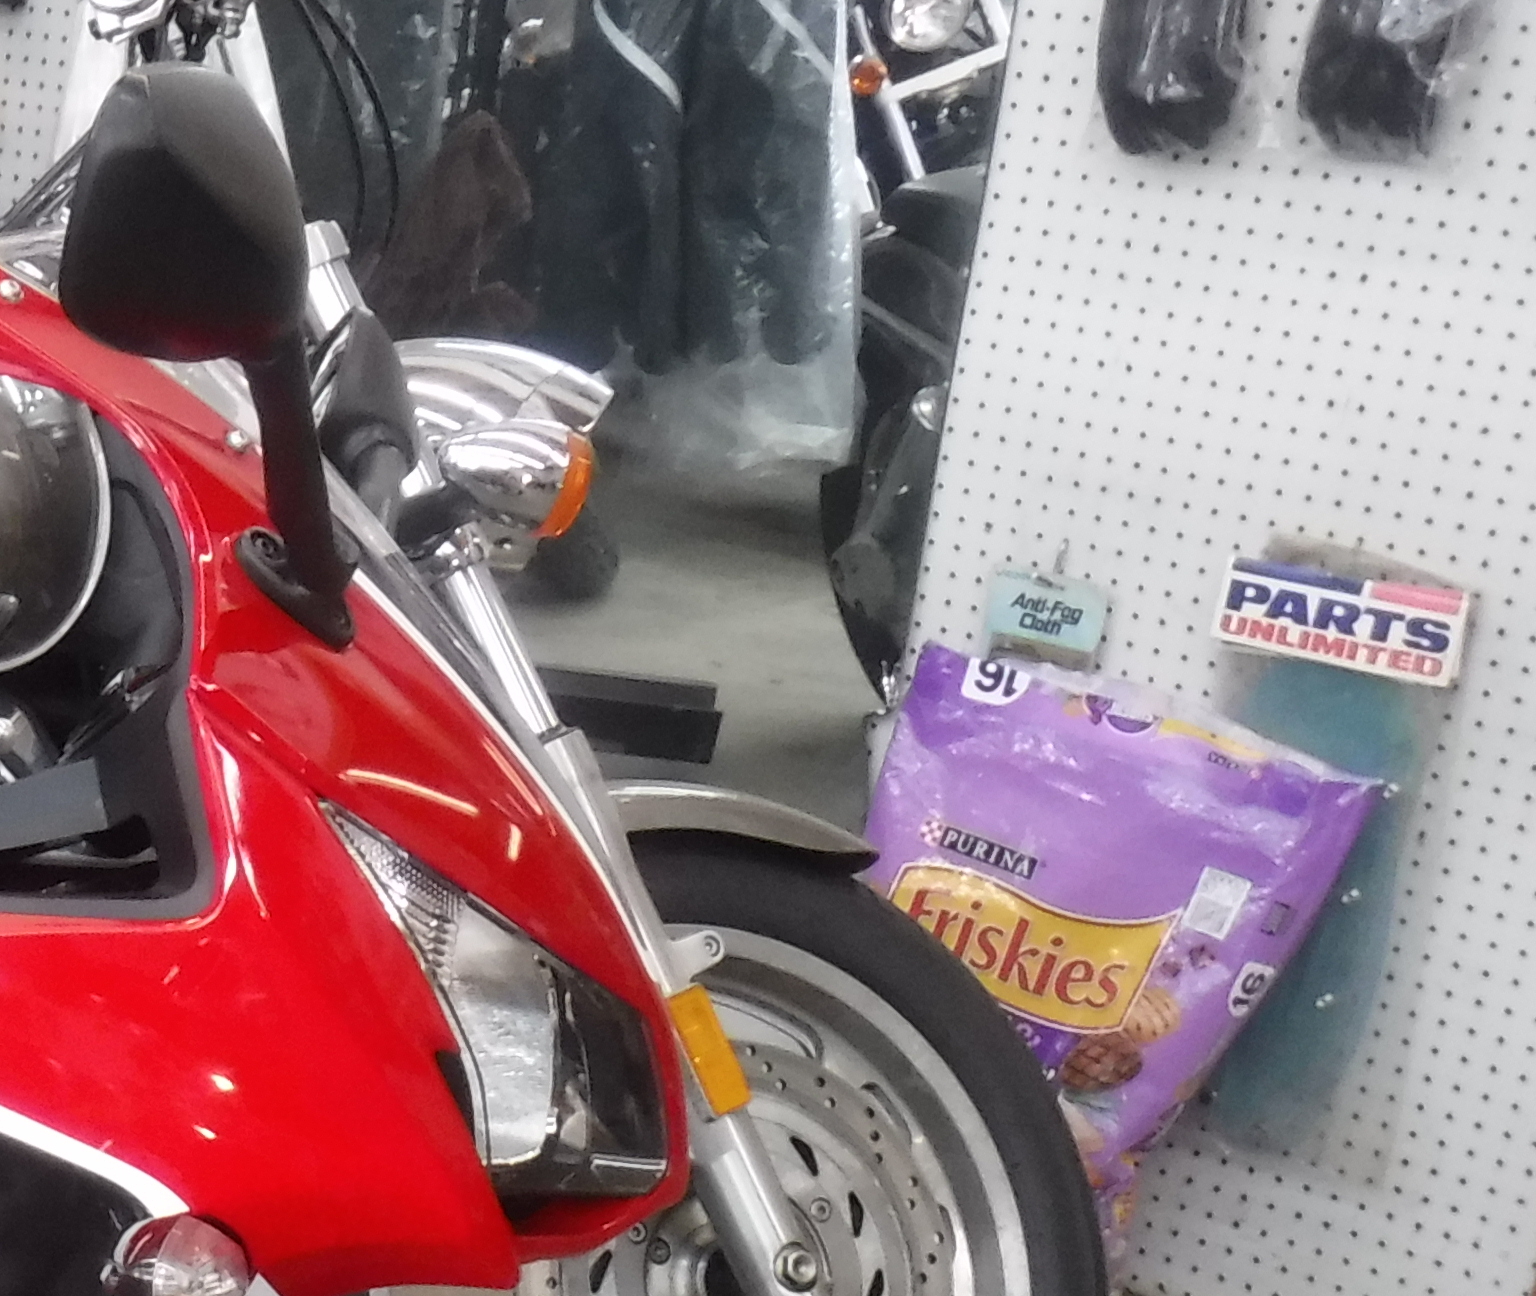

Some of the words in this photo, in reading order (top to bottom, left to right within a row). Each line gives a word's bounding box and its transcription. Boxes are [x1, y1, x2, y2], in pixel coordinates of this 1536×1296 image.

[1010, 592, 1084, 625] Anti-Fog
[1019, 612, 1062, 635] Cloth
[1226, 578, 1451, 653] PARTS
[1219, 613, 1443, 677] UNLIMITED
[974, 660, 1017, 697] 16
[943, 829, 1030, 877] PURINA
[909, 889, 1128, 1008] Friskies
